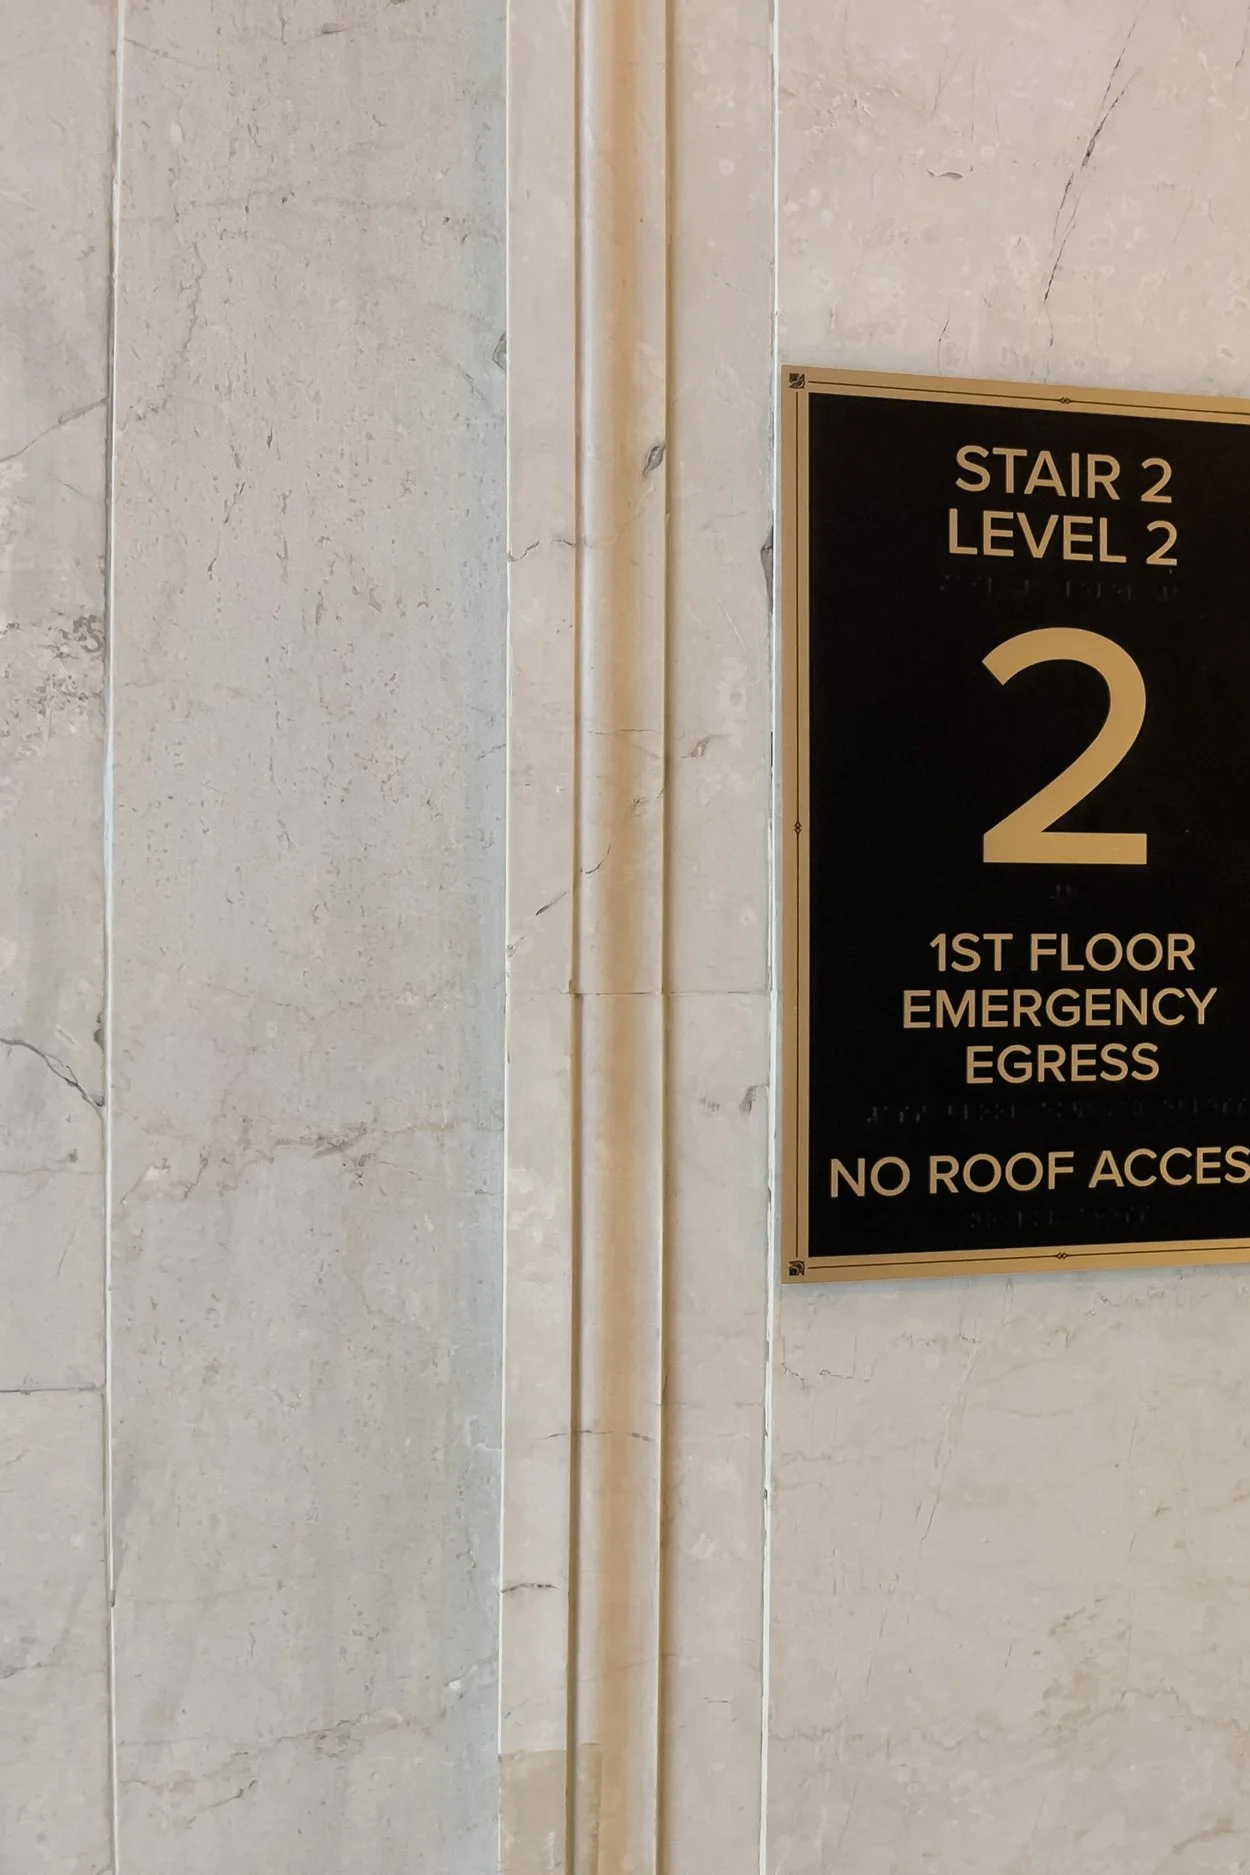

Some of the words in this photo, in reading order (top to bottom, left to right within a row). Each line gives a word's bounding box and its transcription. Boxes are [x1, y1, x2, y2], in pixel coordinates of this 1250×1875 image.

[955, 445, 1121, 500] STAIR
[1141, 457, 1173, 504] 2
[948, 508, 1127, 563] LEVEL
[1146, 520, 1178, 566] 2
[981, 627, 1148, 865] 2
[930, 932, 1014, 972] 1ST
[1030, 932, 1196, 972] FLOOR
[903, 987, 1218, 1029] EMERGENCY
[966, 1042, 1160, 1084] EGRESS
[830, 1156, 910, 1198] NO
[929, 1151, 1075, 1194] ROOF
